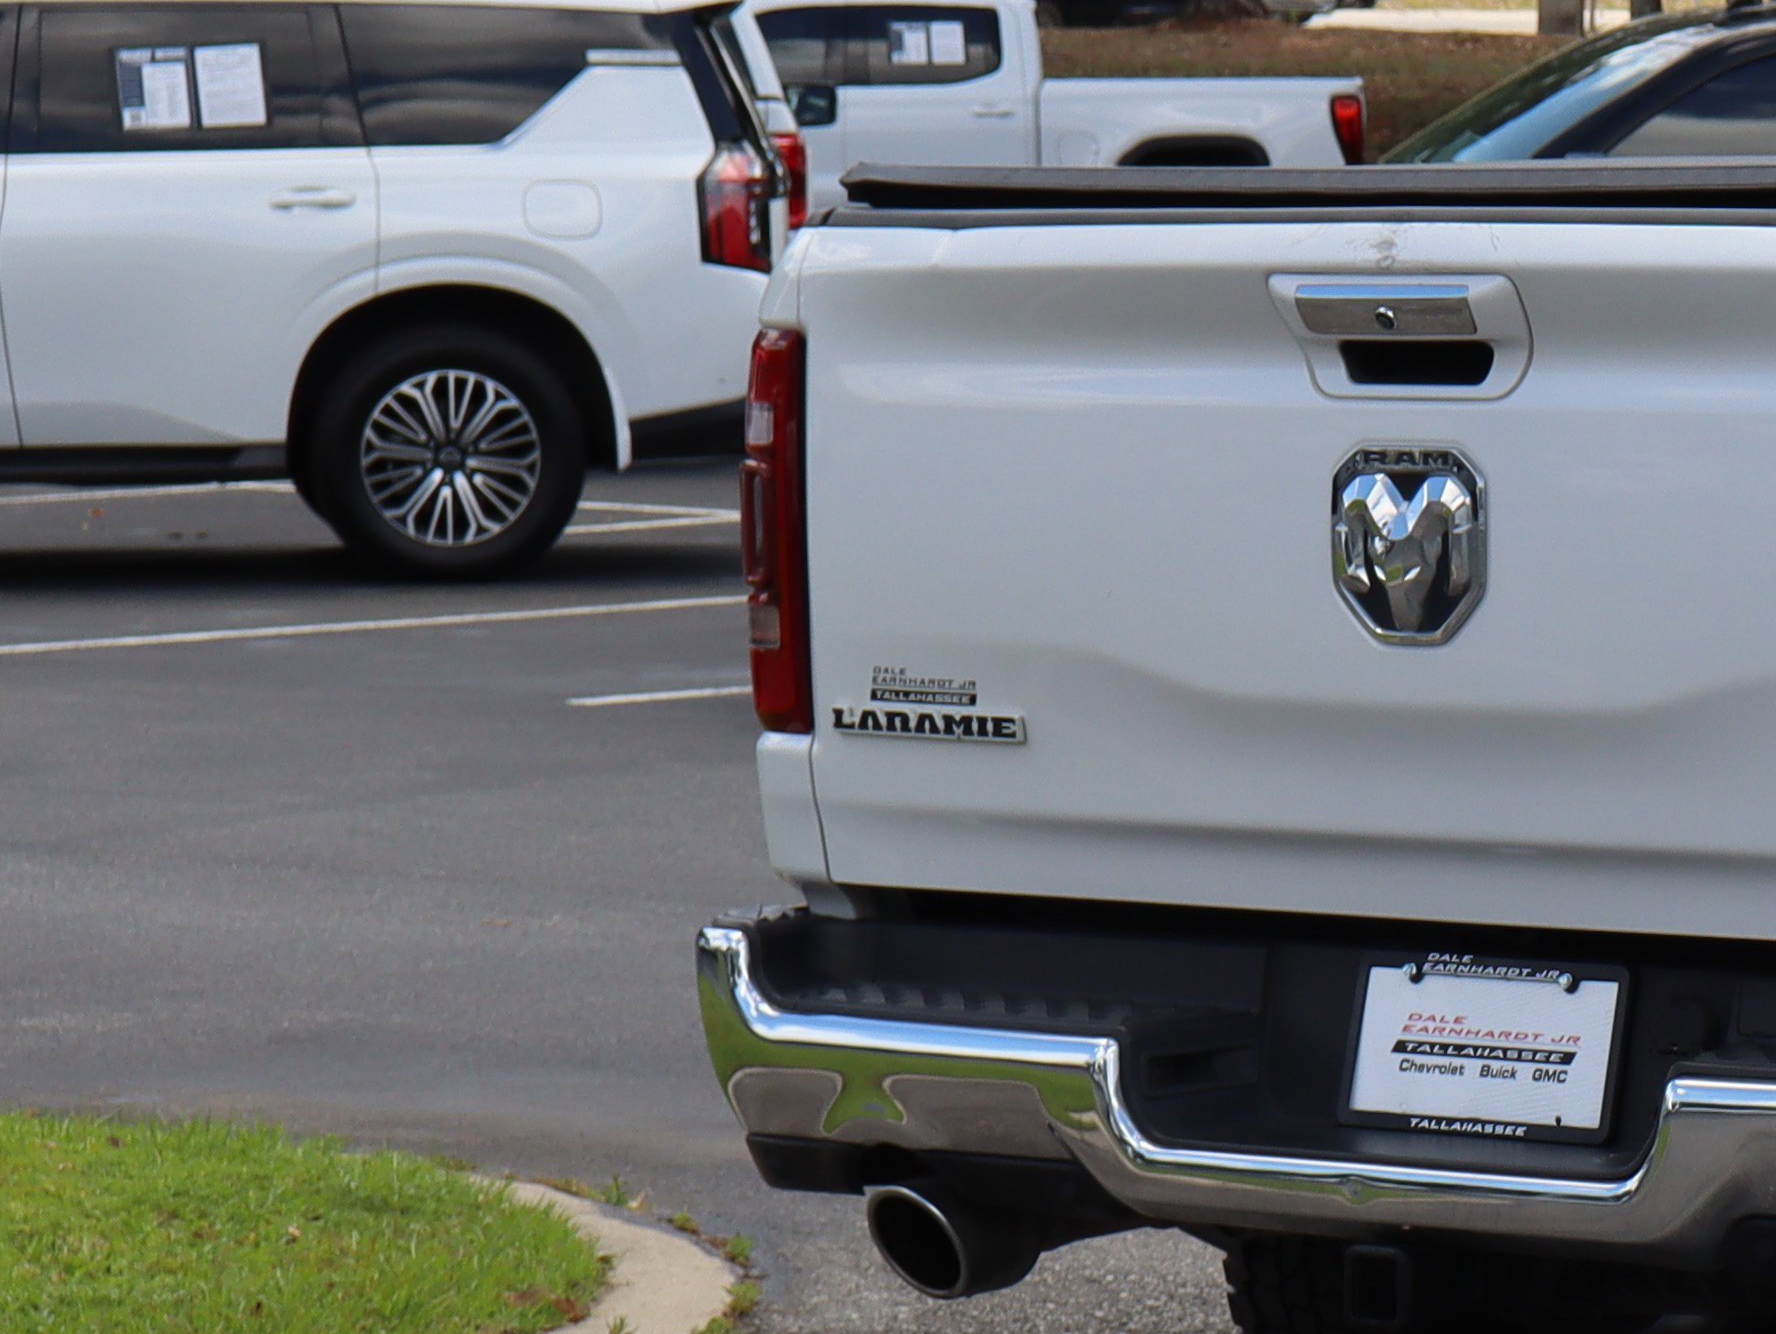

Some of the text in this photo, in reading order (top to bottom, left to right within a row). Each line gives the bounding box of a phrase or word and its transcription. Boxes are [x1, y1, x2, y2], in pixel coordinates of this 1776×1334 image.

[1363, 449, 1450, 467] RAM
[872, 666, 906, 676] DALE
[871, 675, 955, 688] EARNHARDT
[874, 689, 972, 705] TALLAHASSEE
[831, 707, 1018, 739] LARAMIE
[1427, 952, 1474, 964] DALE
[1421, 962, 1533, 978] EARNHARDT
[1407, 1012, 1469, 1025] DALE
[1401, 1023, 1583, 1046] EARNHARDT JR
[1404, 1041, 1566, 1063] TALLAHASSEE
[1398, 1058, 1569, 1084] Chevrolet Buick GMC
[1409, 1117, 1528, 1137] TALLAHASSEE
